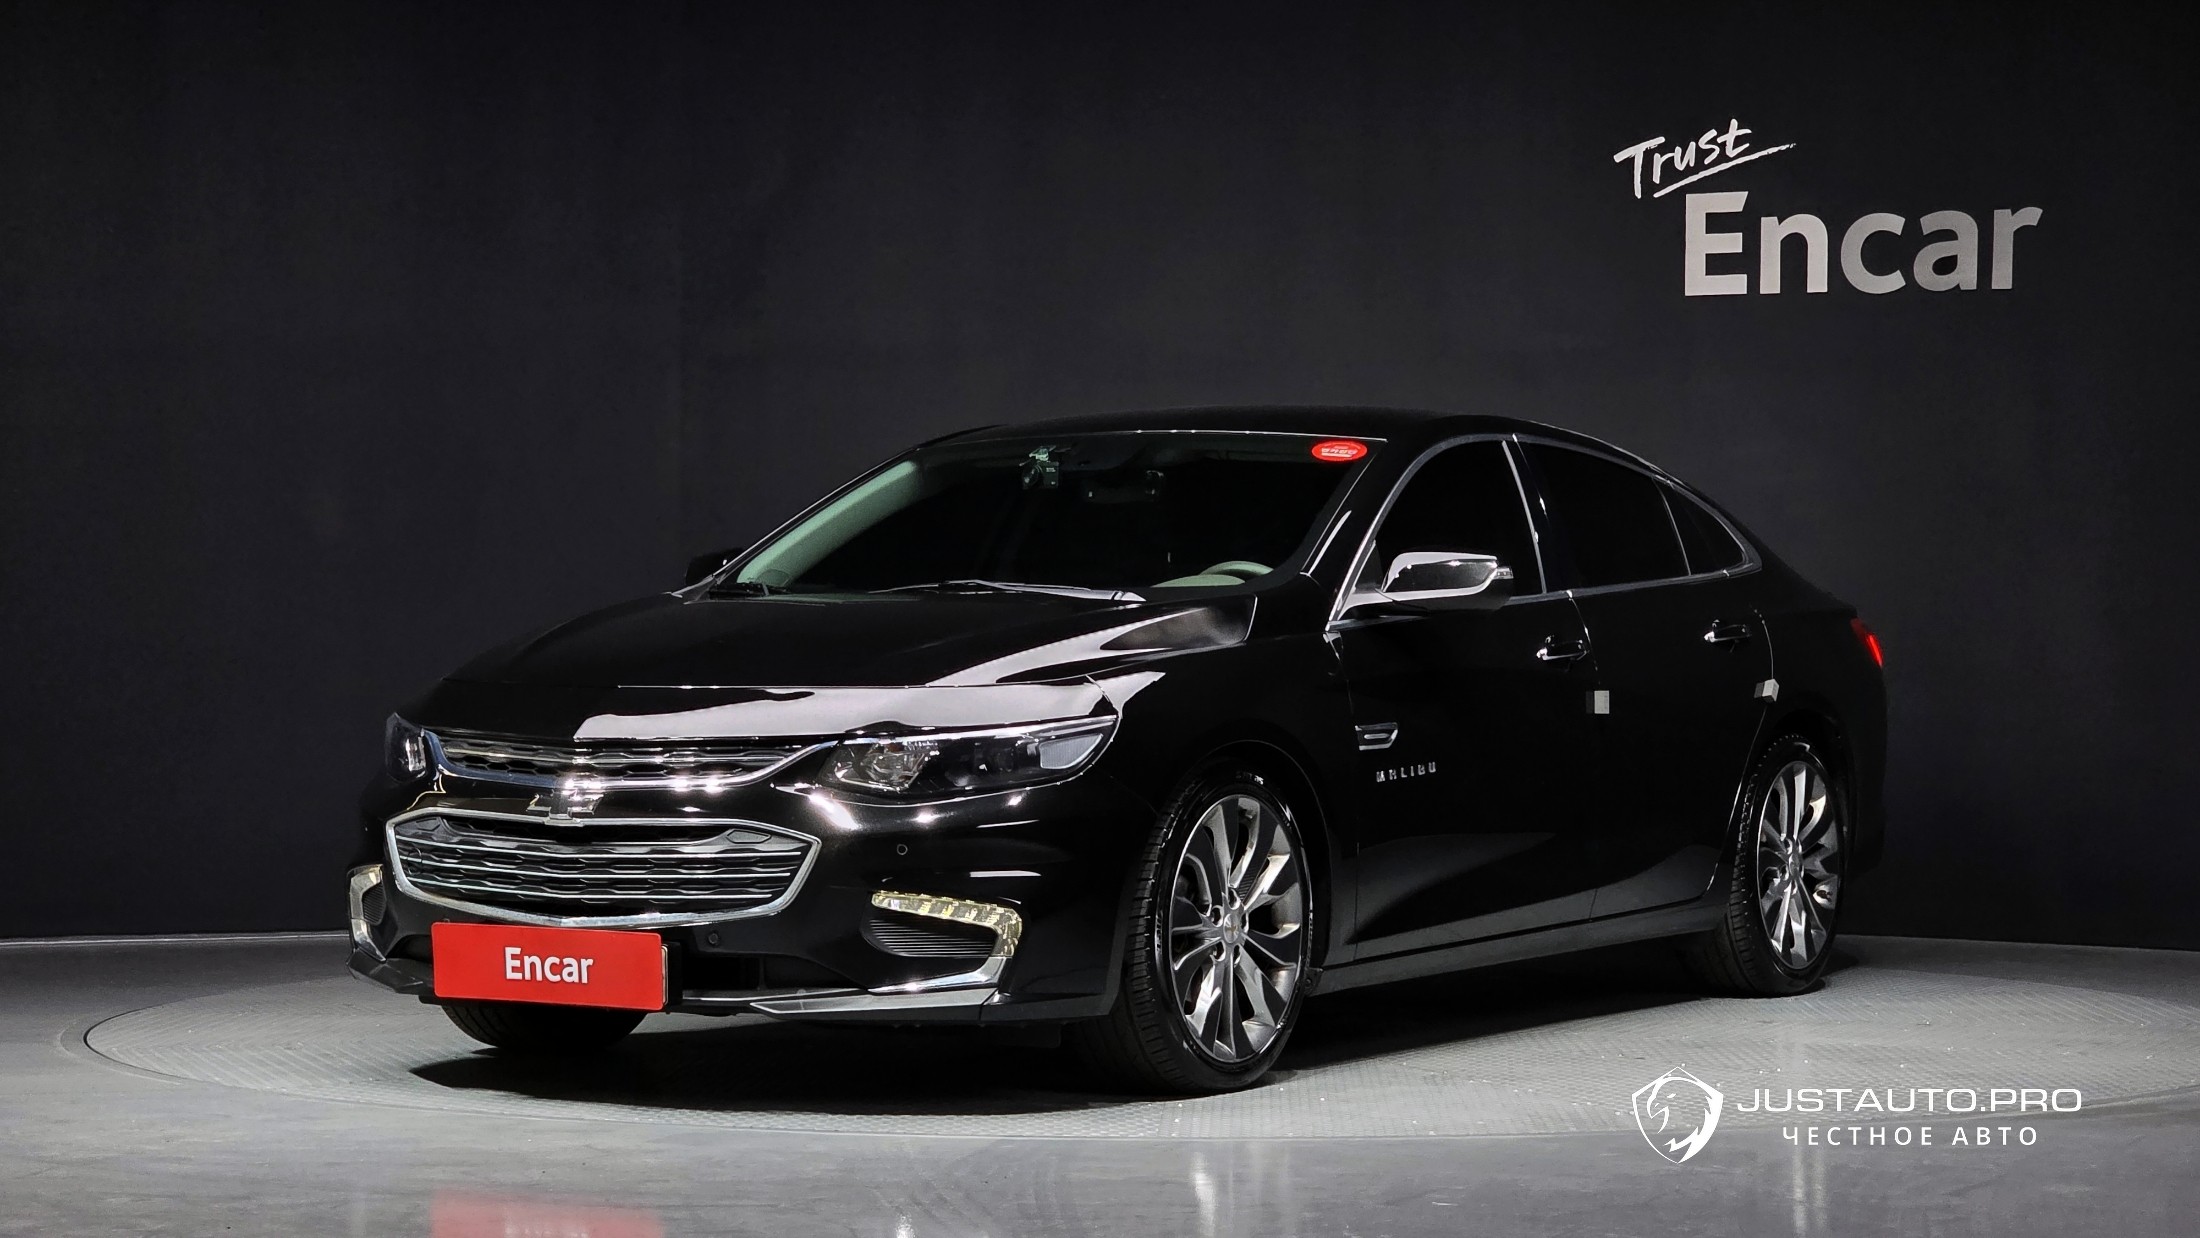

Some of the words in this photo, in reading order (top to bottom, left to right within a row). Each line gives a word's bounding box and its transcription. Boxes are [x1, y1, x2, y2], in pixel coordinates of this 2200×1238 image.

[1614, 118, 1752, 199] Trust
[1685, 191, 2043, 296] Encar
[1376, 761, 1436, 782] MALIBU
[504, 946, 594, 984] Encar
